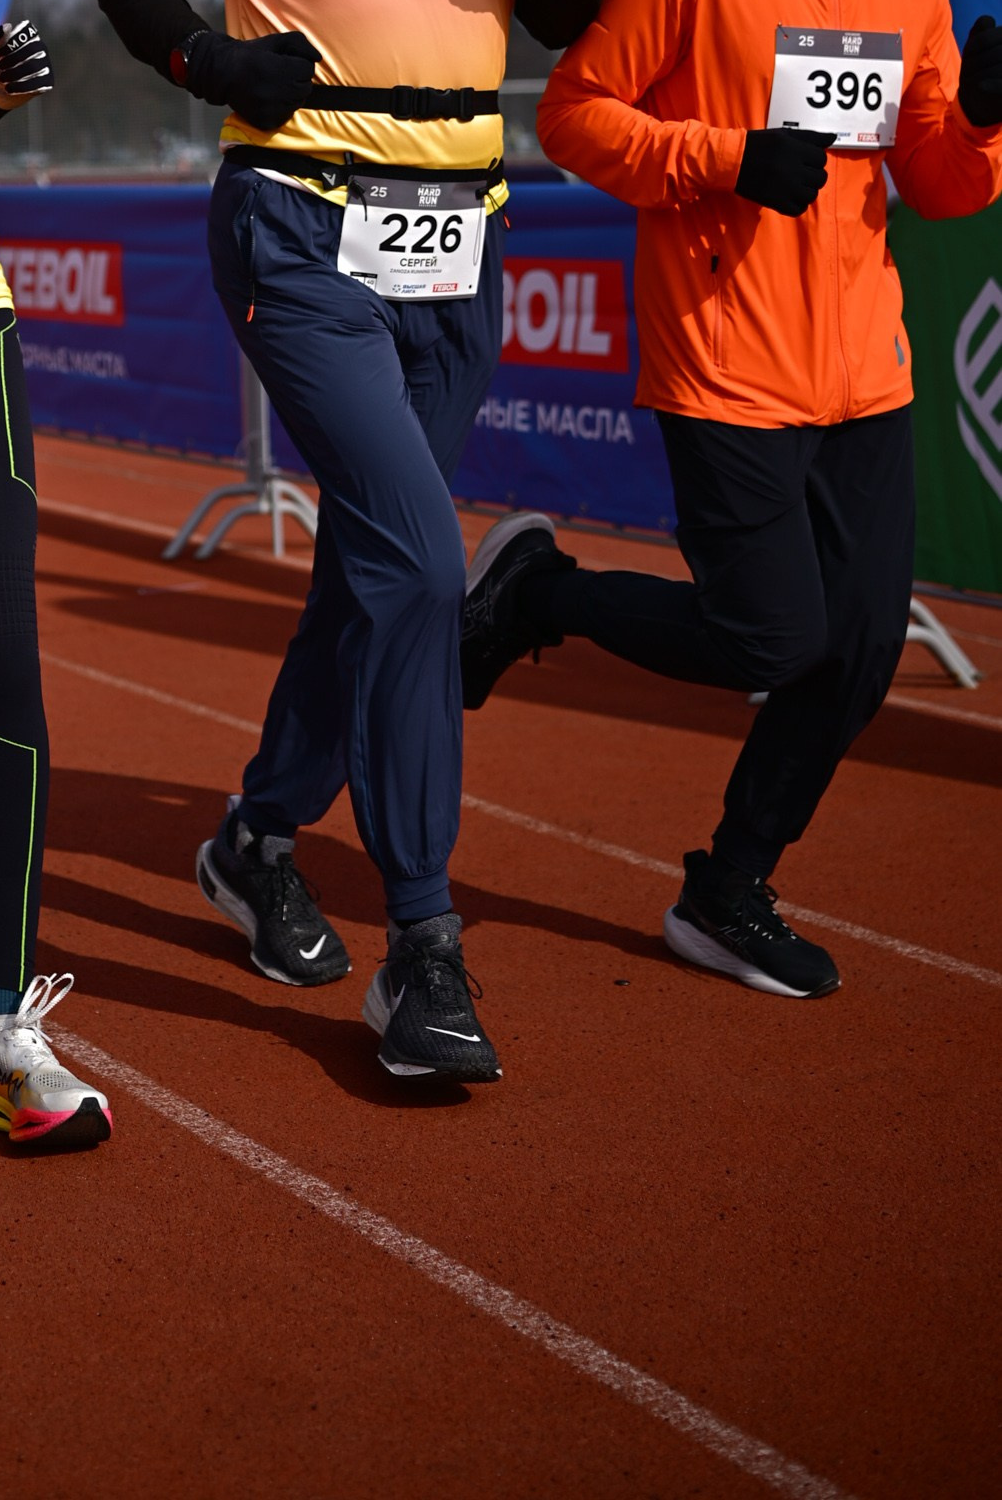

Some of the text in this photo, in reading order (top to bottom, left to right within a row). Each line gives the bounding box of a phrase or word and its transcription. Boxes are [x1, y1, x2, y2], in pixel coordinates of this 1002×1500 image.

[7, 24, 38, 51] MOA
[799, 35, 814, 47] 25
[842, 36, 862, 45] HARD
[844, 44, 859, 53] RUN
[806, 70, 882, 111] 396
[370, 186, 387, 198] 25
[417, 188, 441, 197] HARD
[419, 196, 438, 205] RUN
[379, 213, 463, 254] 226
[400, 256, 438, 267] СЕРГЕЙ
[536, 403, 635, 446] МАСЛА
